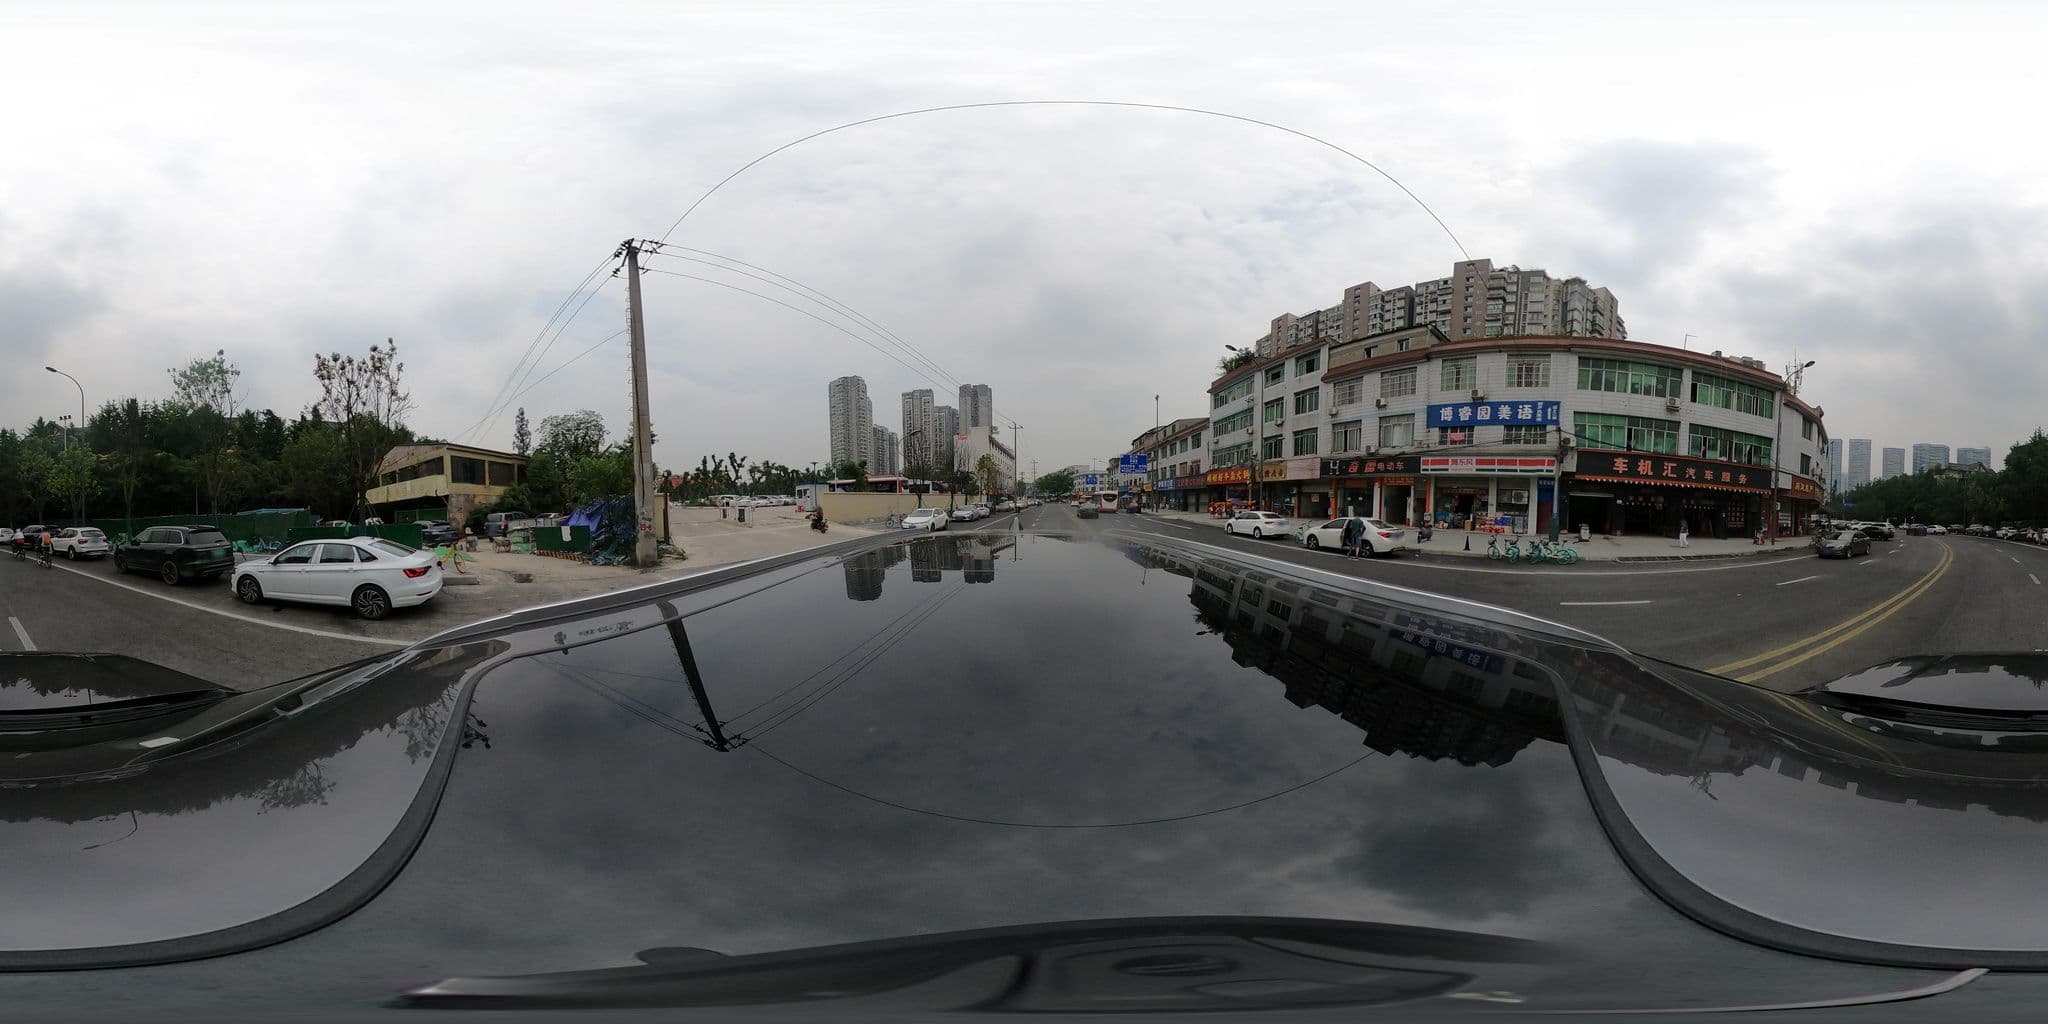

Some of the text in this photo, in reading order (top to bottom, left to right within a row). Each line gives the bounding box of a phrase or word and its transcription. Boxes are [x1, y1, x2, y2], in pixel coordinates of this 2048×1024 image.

[1440, 405, 1533, 421] 博睿园美语
[1612, 458, 1748, 485] 车机汇 汽车服务
